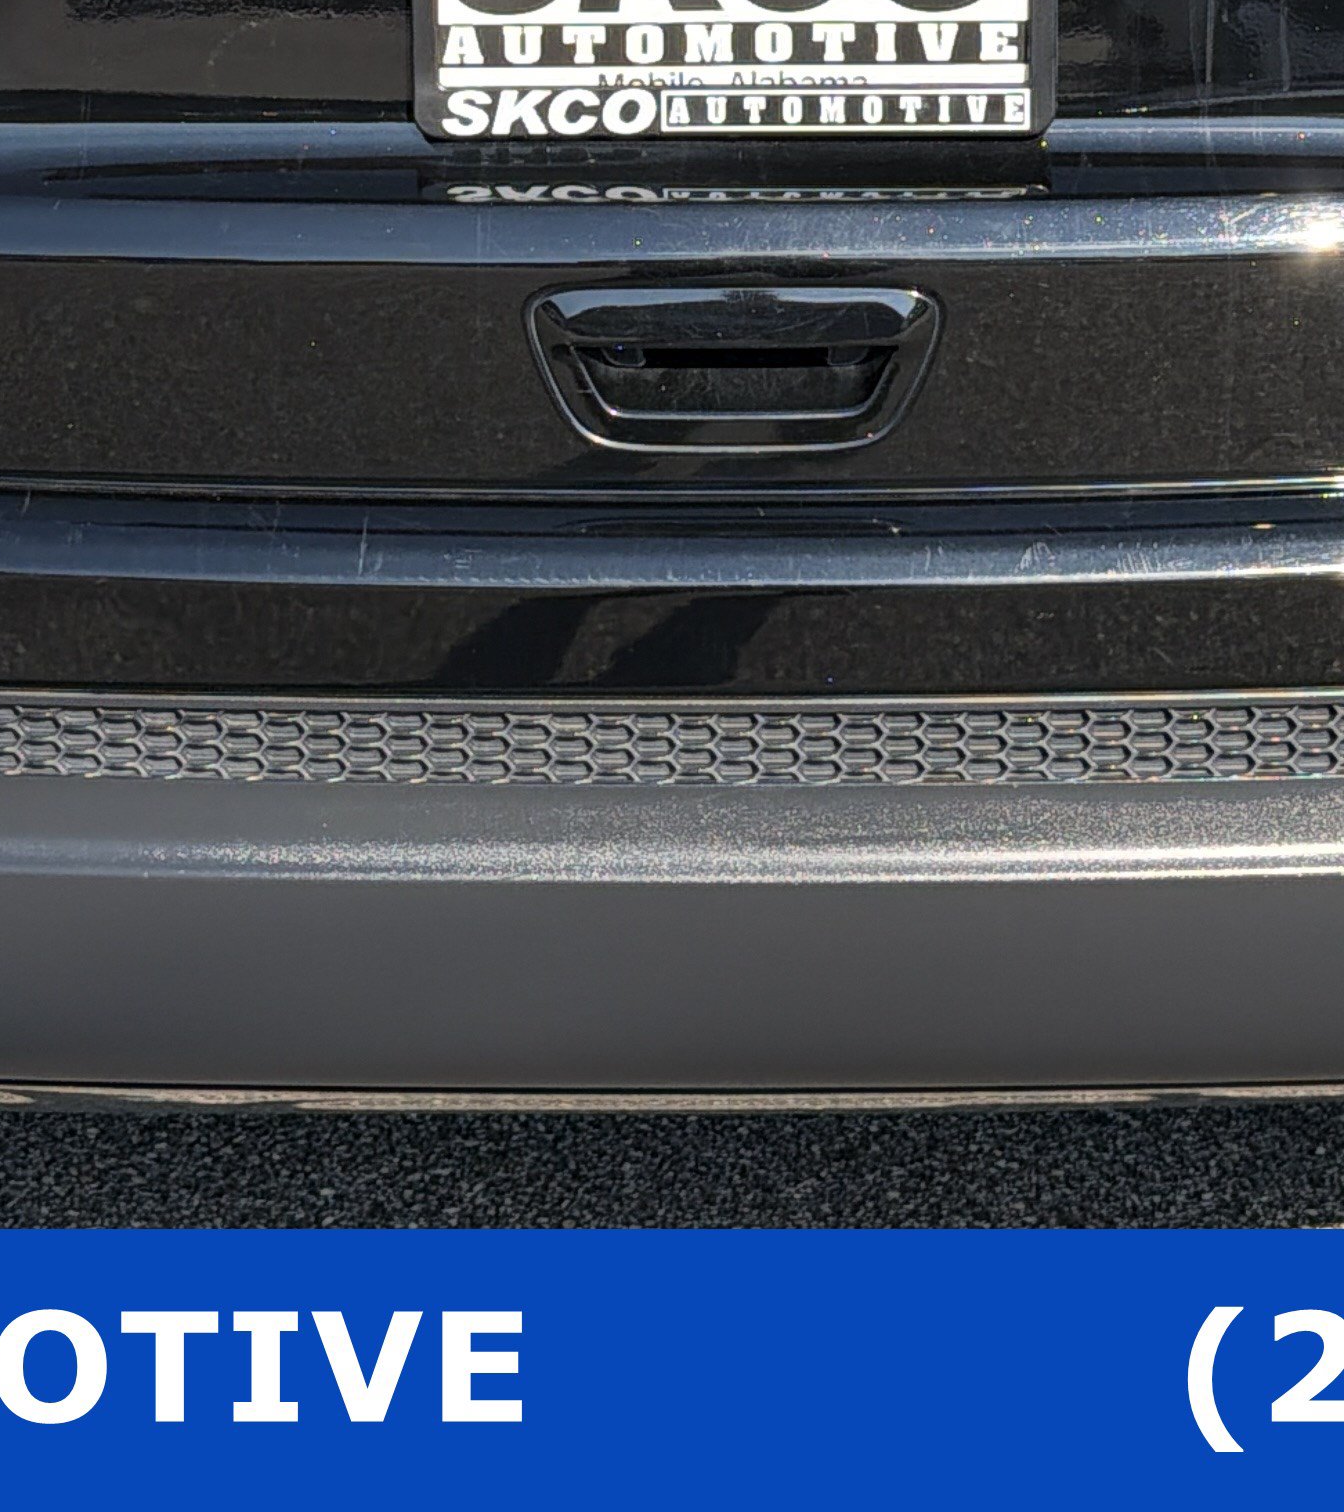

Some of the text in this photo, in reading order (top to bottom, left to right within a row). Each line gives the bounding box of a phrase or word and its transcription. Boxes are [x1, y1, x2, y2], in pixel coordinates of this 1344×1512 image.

[444, 23, 1019, 65] AUTOMOTIVE
[442, 88, 1026, 136] SKCO AUTOMOTIVE
